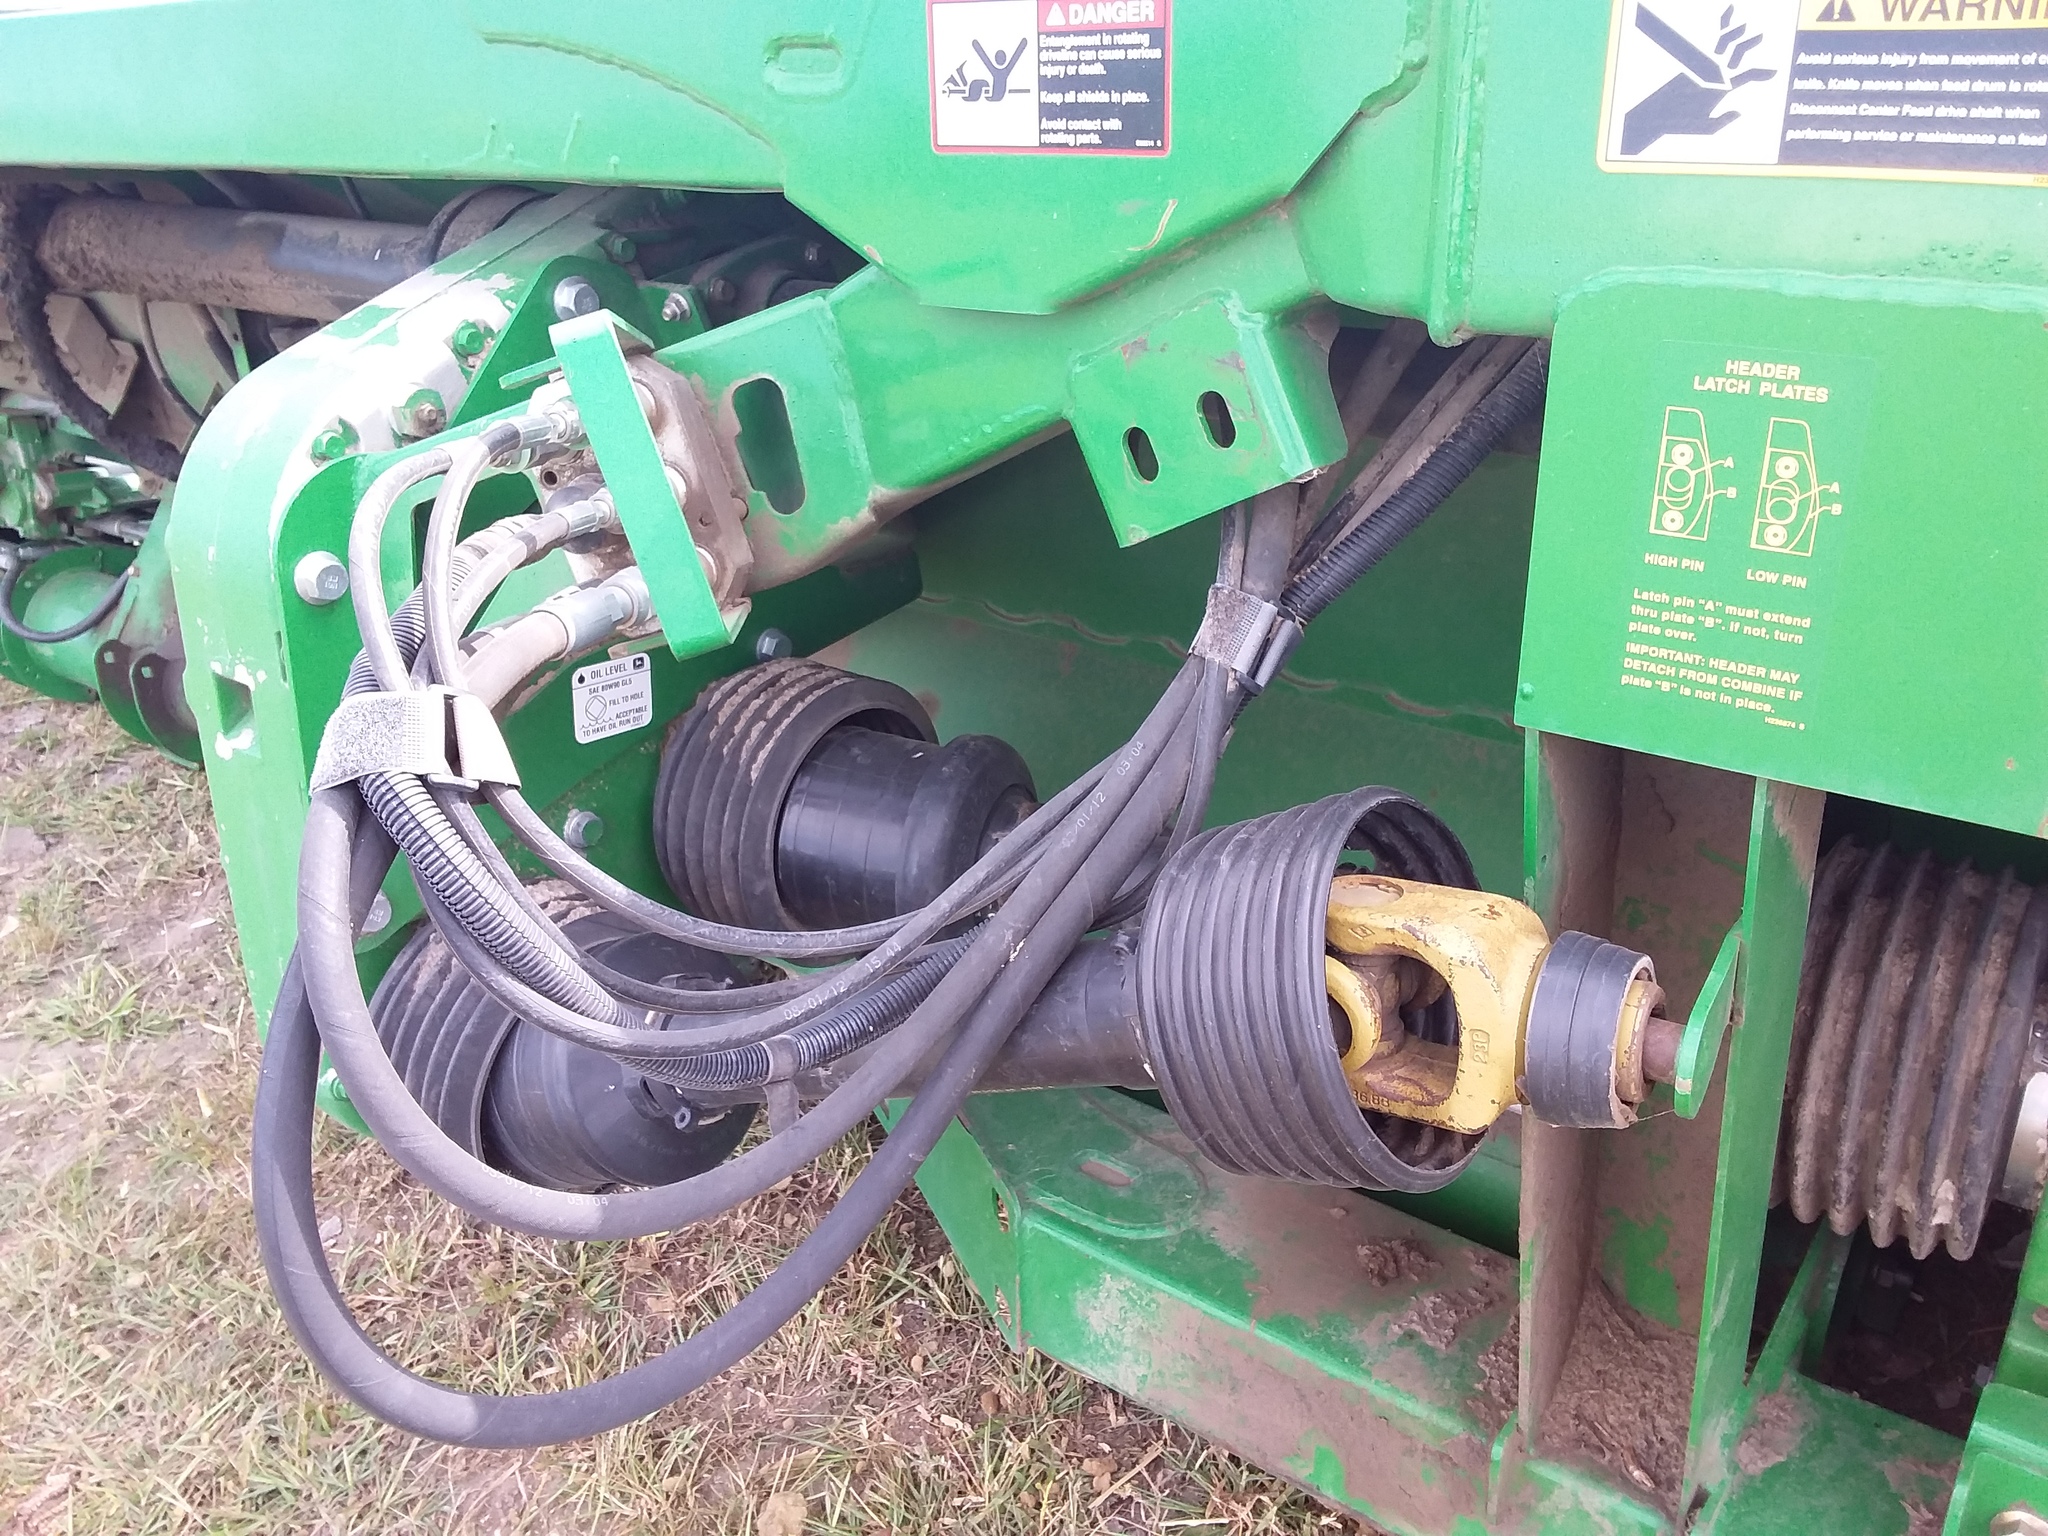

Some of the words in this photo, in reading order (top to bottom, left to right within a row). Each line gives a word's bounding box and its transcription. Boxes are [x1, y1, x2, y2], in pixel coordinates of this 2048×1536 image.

[1068, 0, 1155, 25] DANGER
[1881, 0, 2048, 22] WARNI
[1102, 32, 1112, 46] in
[1113, 31, 1150, 47] rotating
[1079, 50, 1096, 61] can
[1097, 49, 1126, 60] cause
[1126, 47, 1162, 59] serious
[1796, 52, 1832, 65] Avoid
[1833, 52, 1879, 65] serious
[1880, 52, 1918, 68] injury
[1919, 52, 1949, 65] from
[1950, 52, 2020, 66] movement
[2021, 52, 2037, 65] of
[1040, 63, 1066, 79] injury
[1066, 65, 1078, 76] or
[1078, 62, 1107, 75] death.
[1861, 79, 1903, 91] moves
[1905, 79, 1940, 91] when
[1971, 79, 2007, 92] drum
[2008, 79, 2022, 92] is
[1040, 91, 1064, 106] Keep
[1064, 91, 1076, 103] all
[1077, 90, 1110, 103] shields
[1110, 90, 1121, 103] in
[1121, 90, 1150, 106] place.
[1789, 102, 1857, 115] Disconnect
[1858, 103, 1900, 116] Center
[1902, 104, 1934, 117] Feed
[1935, 104, 1967, 118] drive
[1969, 105, 2002, 119] shaft
[2004, 106, 2041, 119] when
[1040, 117, 1067, 130] Avoid
[1067, 118, 1102, 130] contact
[1102, 118, 1123, 130] with
[1040, 132, 1075, 146] rotating
[1076, 132, 1102, 147] parts.
[1785, 128, 1852, 143] performing
[1853, 129, 1898, 142] service
[1899, 131, 1914, 142] or
[1915, 130, 1996, 144] maintenance
[1998, 134, 2016, 145] on
[1725, 359, 1801, 381] HEADER
[1693, 375, 1751, 394] LATCH
[1759, 382, 1829, 403] PLATES
[1724, 456, 1734, 469] A
[1726, 487, 1737, 499] B
[1829, 481, 1841, 494] A
[1831, 503, 1843, 516] B
[1644, 552, 1678, 568] HIGH
[1681, 557, 1705, 572] PIN
[1746, 569, 1779, 584] LOW
[1782, 574, 1808, 589] PIN
[1633, 587, 1670, 604] Latch
[1673, 594, 1696, 609] pin
[1725, 603, 1760, 620] must
[1762, 610, 1812, 629] extend
[1628, 621, 1662, 636] plate
[1664, 628, 1697, 642] over.
[1631, 604, 1658, 619] thru
[1661, 606, 1696, 625] plate
[1743, 624, 1770, 640] not,
[1773, 629, 1804, 645] turn
[590, 670, 603, 680] OIL
[605, 663, 628, 676] LEVEL
[1625, 641, 1706, 666] IMPORTANT:
[1708, 657, 1767, 678] HEADER
[1769, 669, 1801, 685] MAY
[1623, 657, 1676, 677] DETACH
[1678, 668, 1718, 686] FROM
[1721, 677, 1786, 699] COMBINE
[1789, 689, 1804, 702] IF
[588, 686, 599, 695] SAE
[1620, 673, 1653, 689] plate
[1679, 684, 1692, 696] is
[1694, 688, 1717, 702] not
[1719, 693, 1732, 705] in
[1735, 696, 1775, 713] place.
[609, 698, 620, 707] FILL
[622, 696, 629, 704] TO
[615, 705, 648, 719] ACCEPTABLE
[582, 729, 591, 737] TO
[592, 725, 607, 735] HAVE
[608, 721, 617, 730] OIL
[618, 717, 631, 727] RUN
[632, 714, 644, 723] OUT
